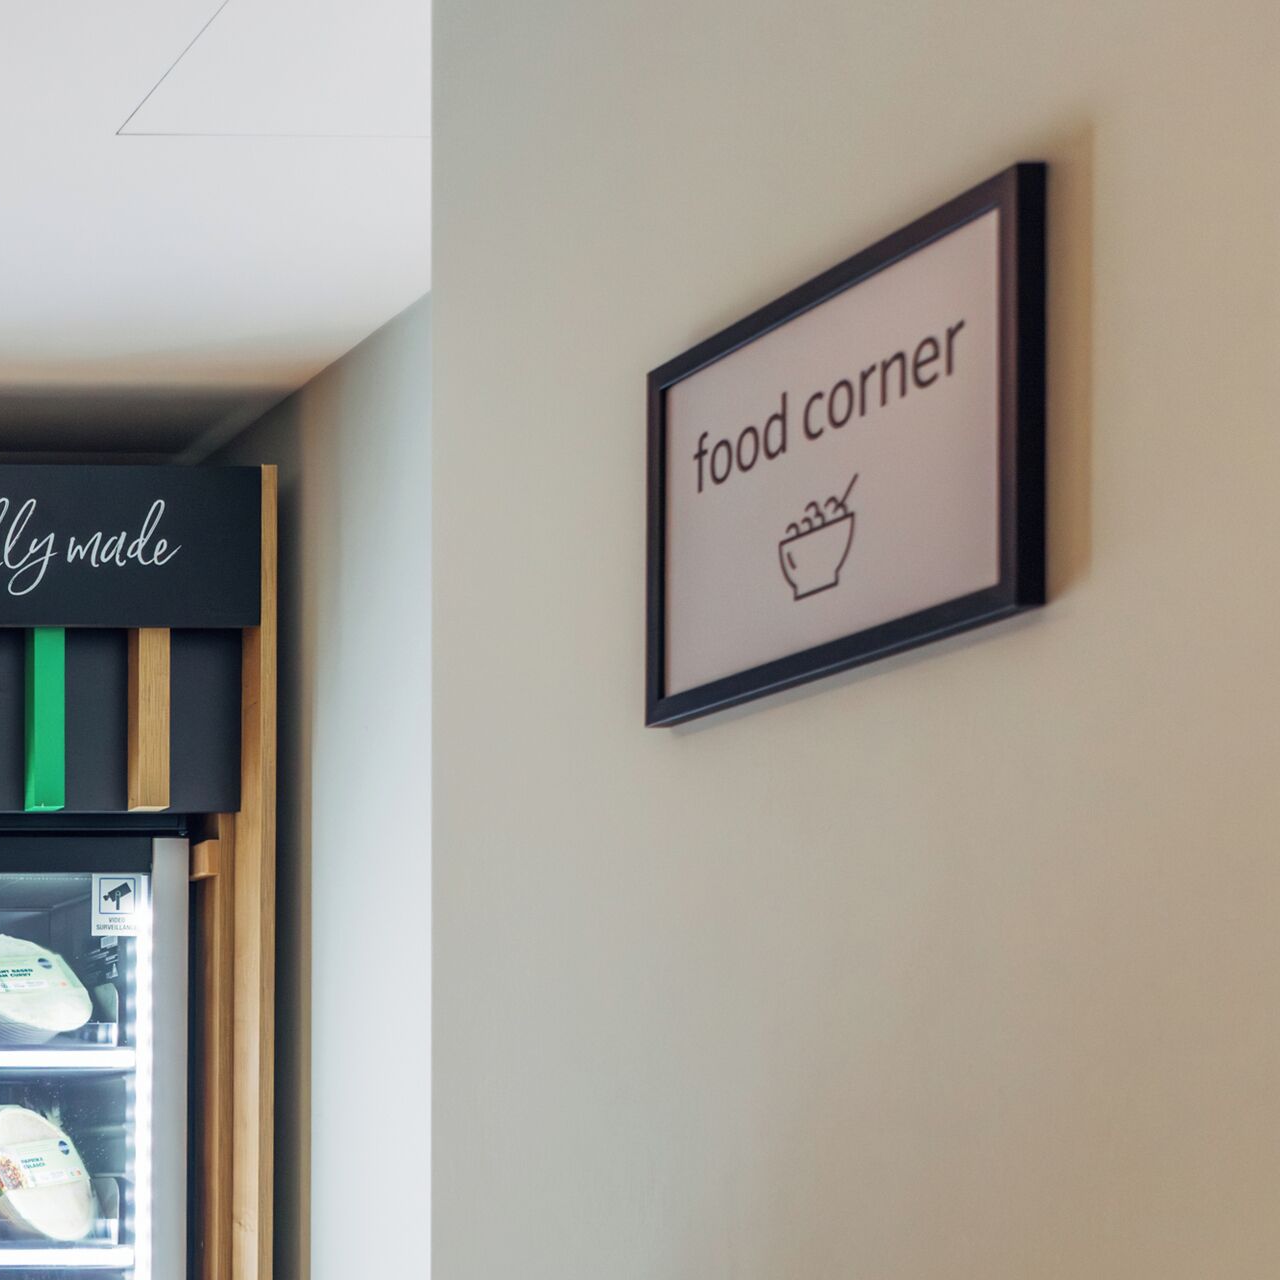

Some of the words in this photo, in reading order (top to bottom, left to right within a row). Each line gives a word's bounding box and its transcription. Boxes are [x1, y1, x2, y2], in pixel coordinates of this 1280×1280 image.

[692, 391, 788, 494] food
[802, 319, 966, 440] corner
[66, 499, 182, 567] made
